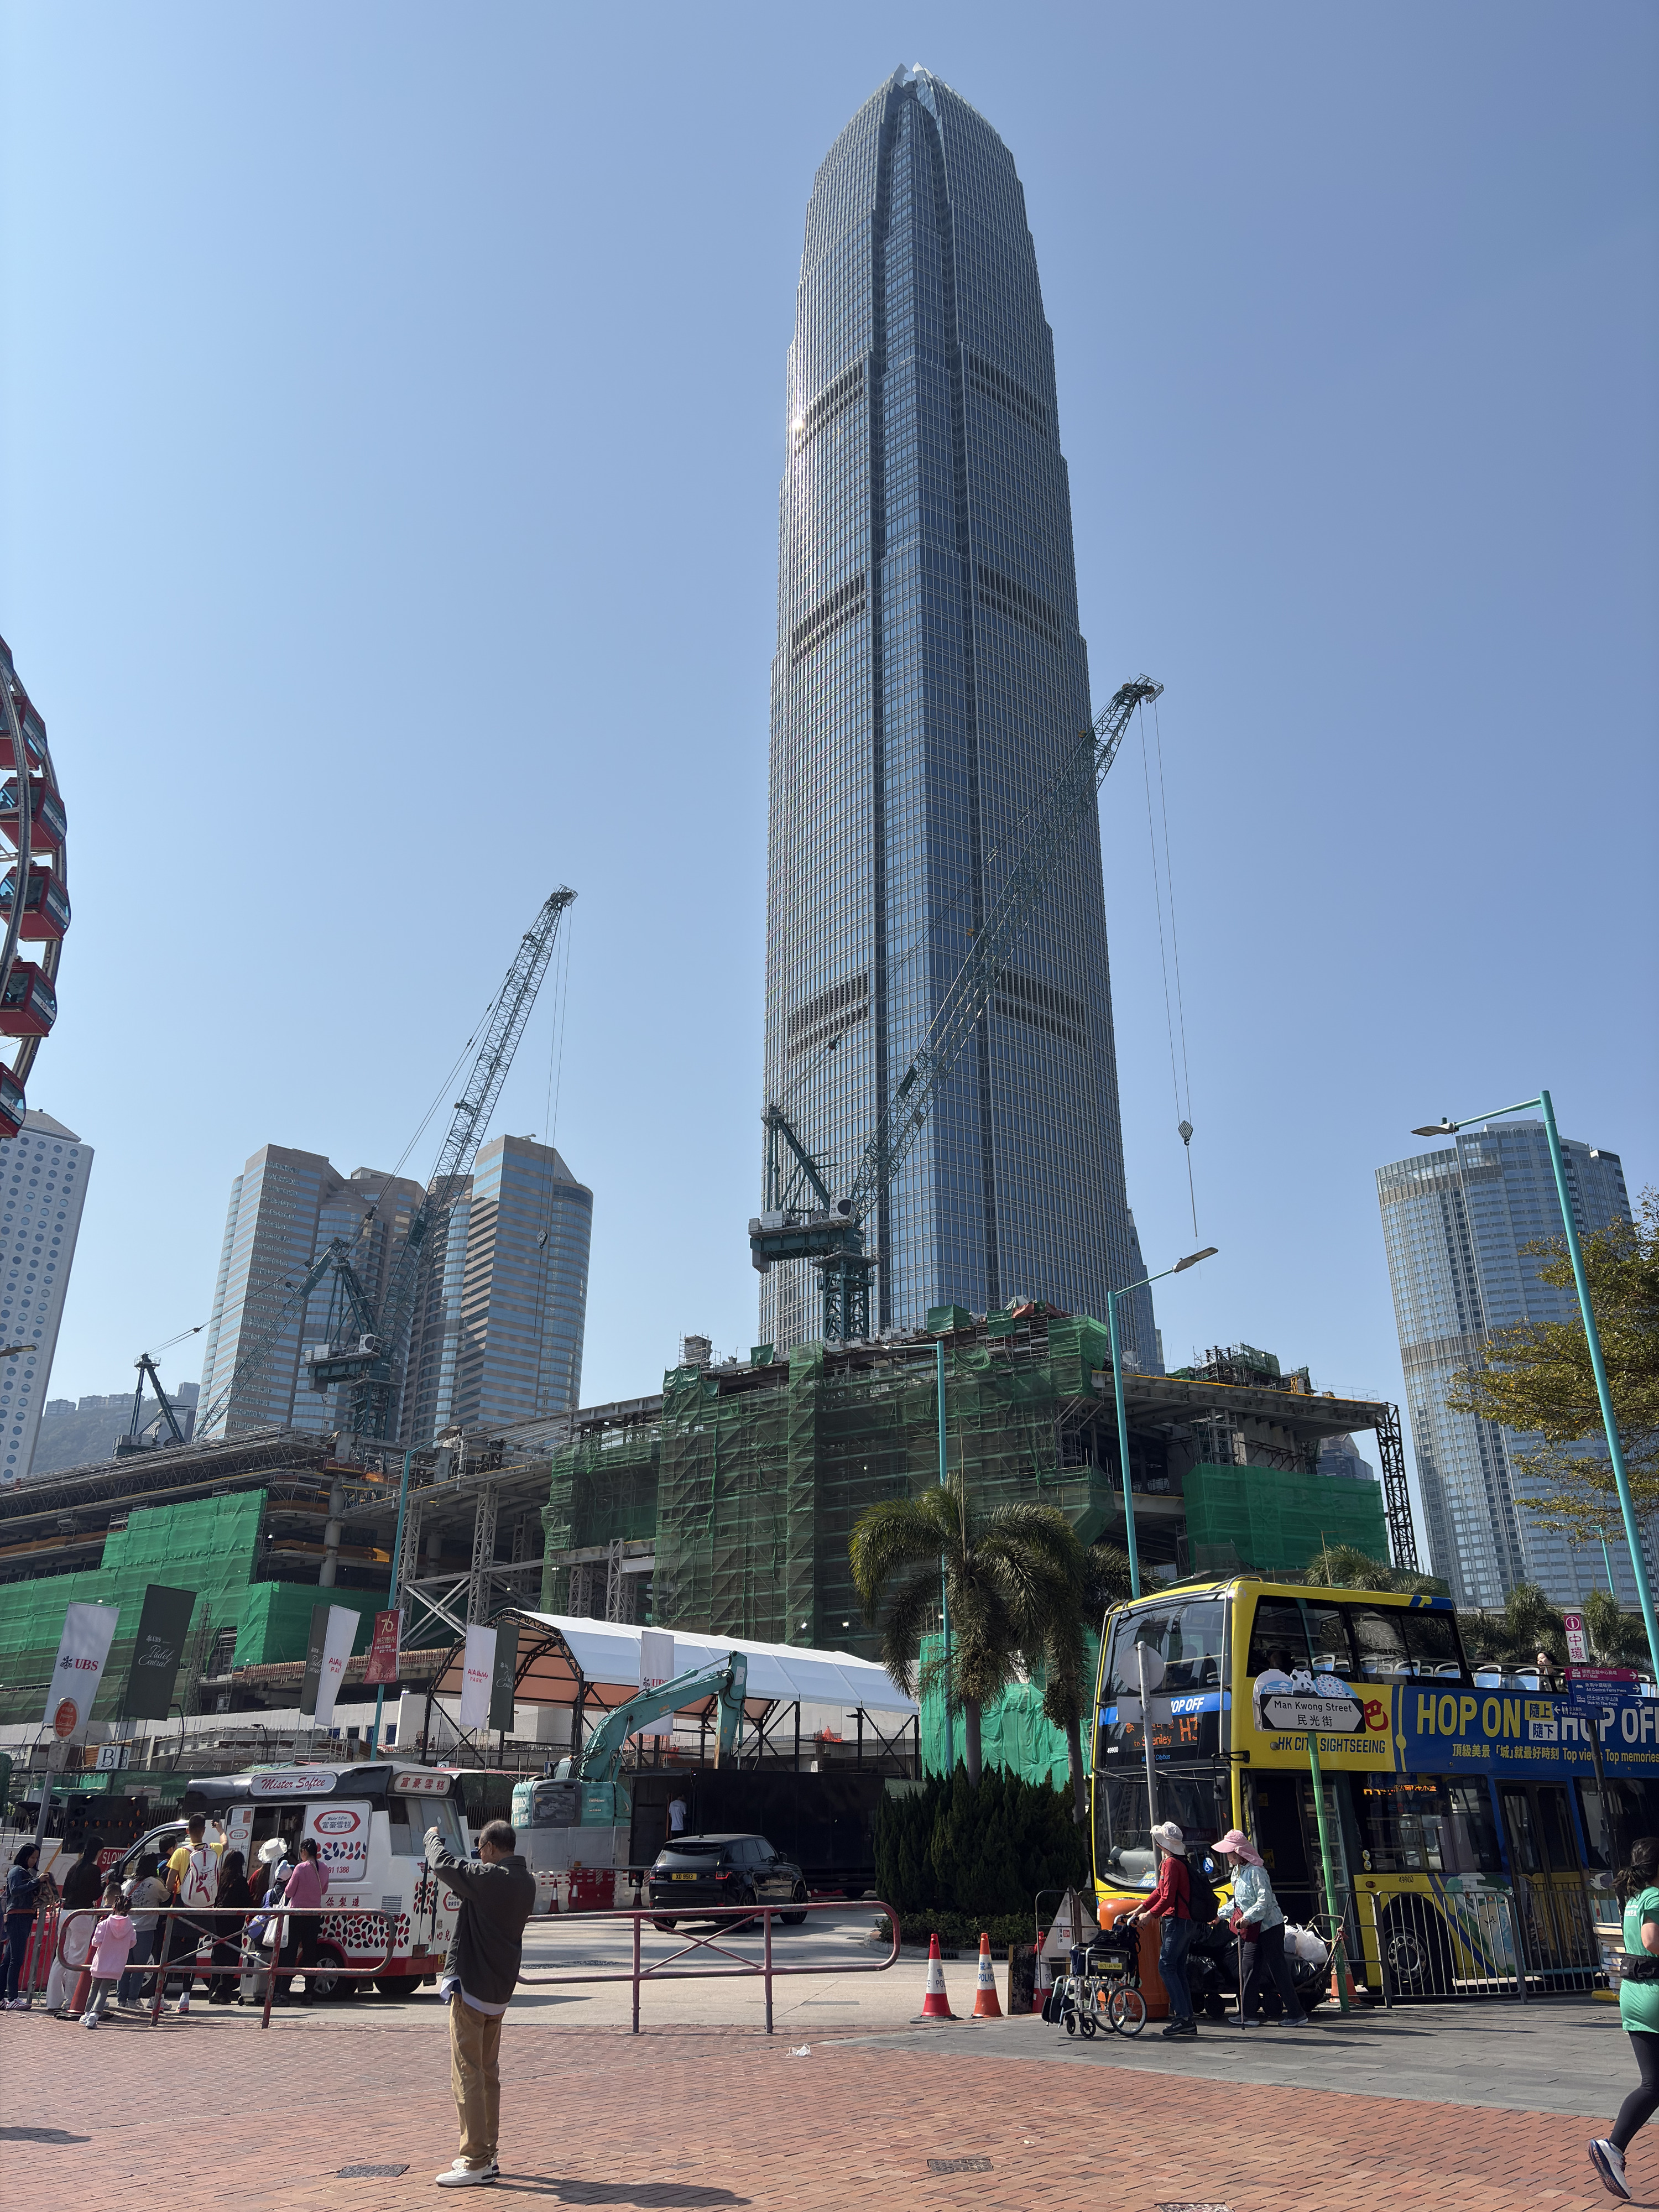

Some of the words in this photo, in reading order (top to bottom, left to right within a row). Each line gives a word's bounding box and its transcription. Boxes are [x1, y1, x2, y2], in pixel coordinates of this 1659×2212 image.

[1569, 1634, 1585, 1660] 中環
[75, 1658, 99, 1671] UBS
[651, 1678, 669, 1687] UB
[1171, 1699, 1186, 1714] OP
[1185, 1697, 1205, 1712] OFF
[1274, 1700, 1292, 1709] Man
[1295, 1701, 1323, 1712] Kwong
[1326, 1703, 1353, 1712] Street
[1529, 1703, 1552, 1720] 隨上
[1297, 1714, 1333, 1727] 民光街
[1416, 1693, 1478, 1736] HOP
[1482, 1698, 1521, 1738] ON
[1532, 1722, 1554, 1740] 隨下
[1278, 1736, 1292, 1751] HK
[1295, 1736, 1318, 1752] CIT
[1320, 1738, 1386, 1754] SIGHTSEEING
[1452, 1743, 1490, 1759] 頂級美景
[101, 1749, 114, 1767] B
[1563, 1747, 1577, 1764] Top
[1578, 1749, 1603, 1762] vies
[1605, 1749, 1619, 1765] Top
[1621, 1750, 1659, 1763] memories
[261, 1778, 294, 1791] Mister
[295, 1777, 326, 1788] Softee
[400, 1777, 445, 1791] 富豪雪糕
[325, 1895, 359, 1907] 你製造
[978, 1974, 995, 1982] POLIC
